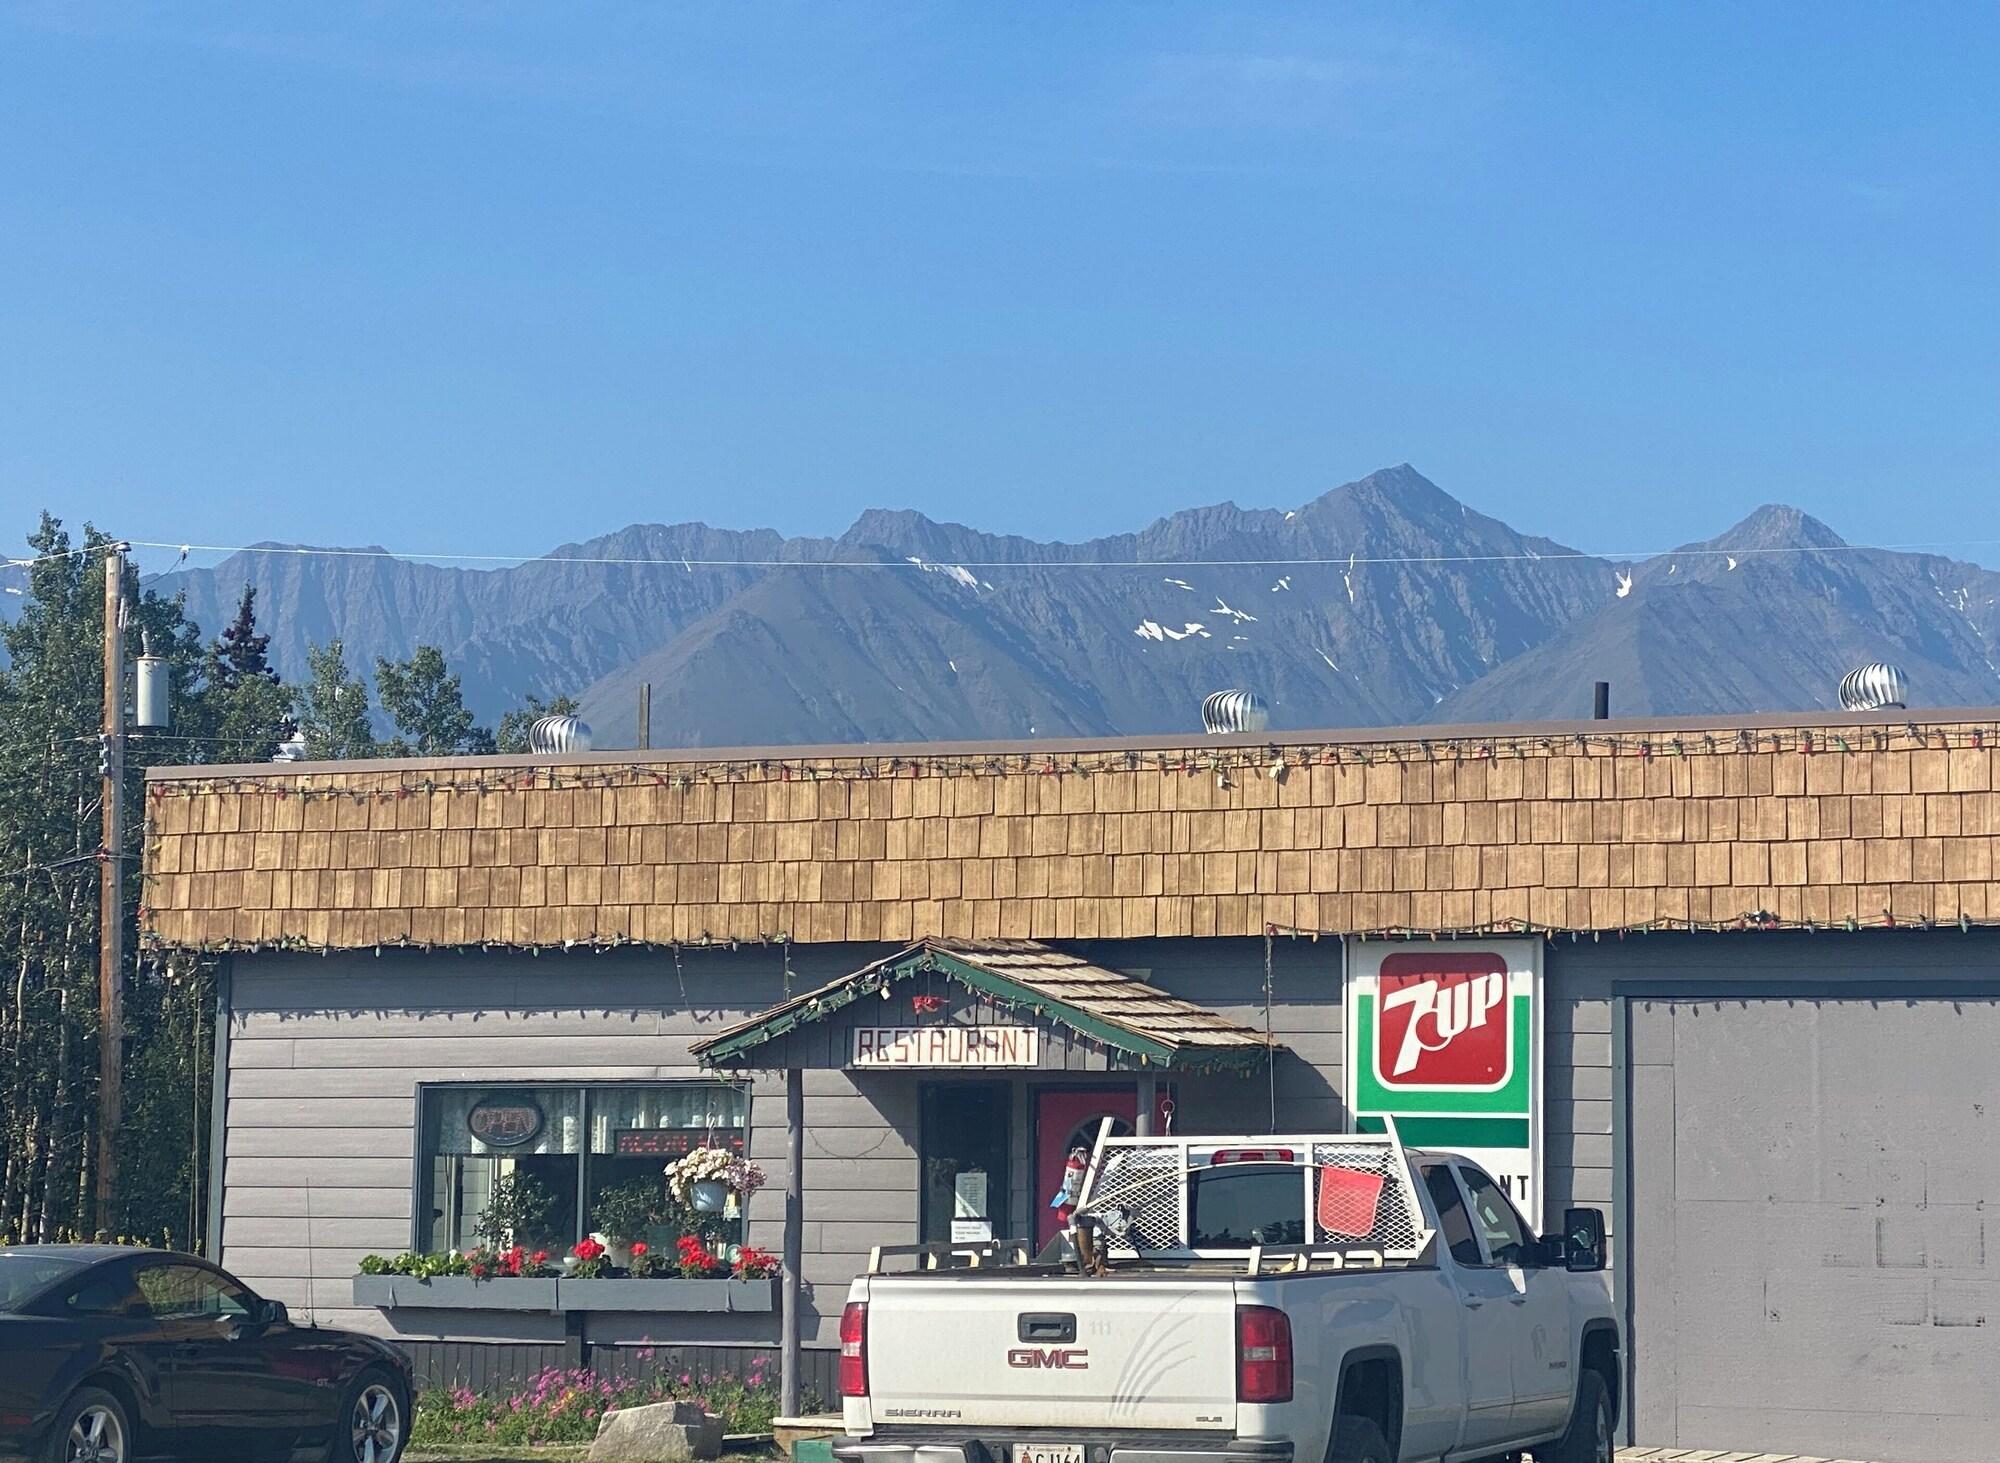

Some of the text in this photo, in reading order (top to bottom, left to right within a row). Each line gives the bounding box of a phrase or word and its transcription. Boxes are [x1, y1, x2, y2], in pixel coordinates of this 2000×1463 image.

[1383, 972, 1504, 1076] 7UP
[858, 1029, 1036, 1062] RESTAURANT
[472, 1109, 536, 1133] OPEN
[1008, 1348, 1089, 1370] GMC
[885, 1408, 962, 1419] SIERRA
